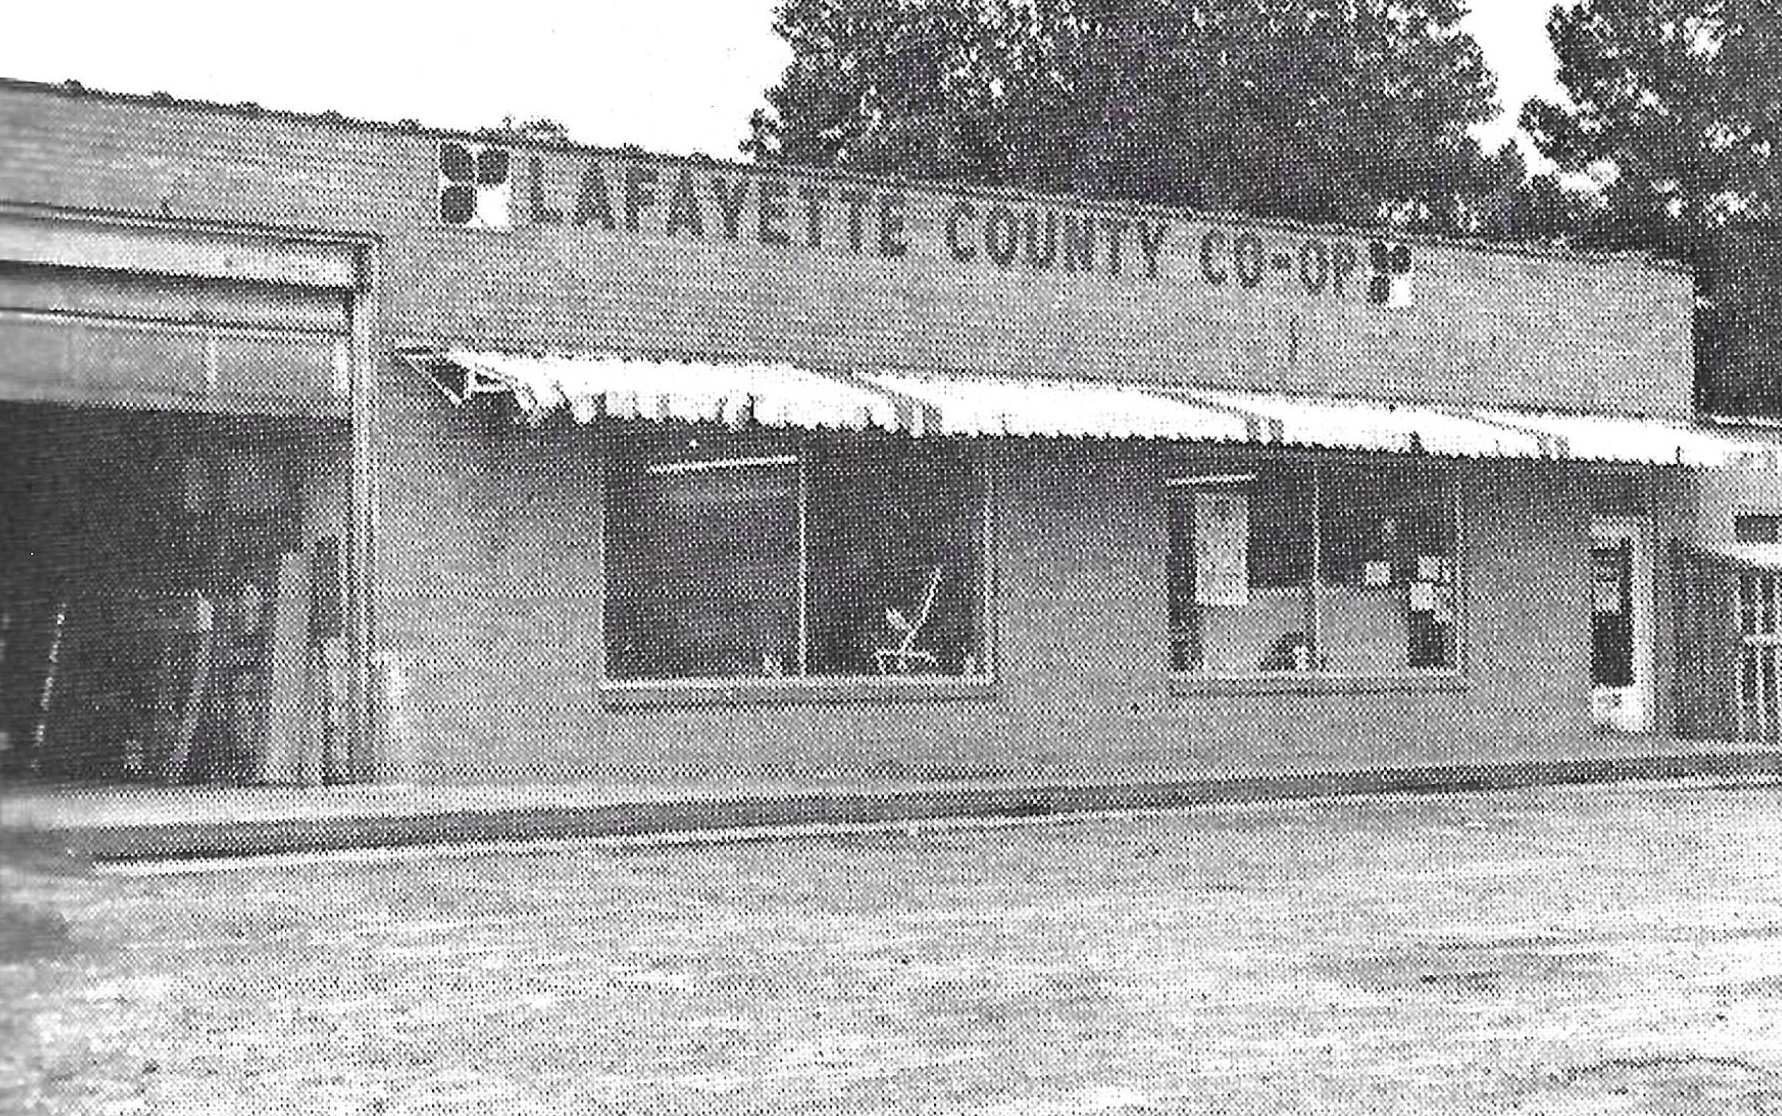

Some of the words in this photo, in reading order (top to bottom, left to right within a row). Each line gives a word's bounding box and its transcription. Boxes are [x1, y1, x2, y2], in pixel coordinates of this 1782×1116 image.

[529, 155, 907, 258] LAFAYETTE
[945, 200, 1169, 279] COUNTY
[1199, 228, 1356, 296] CO-OP
